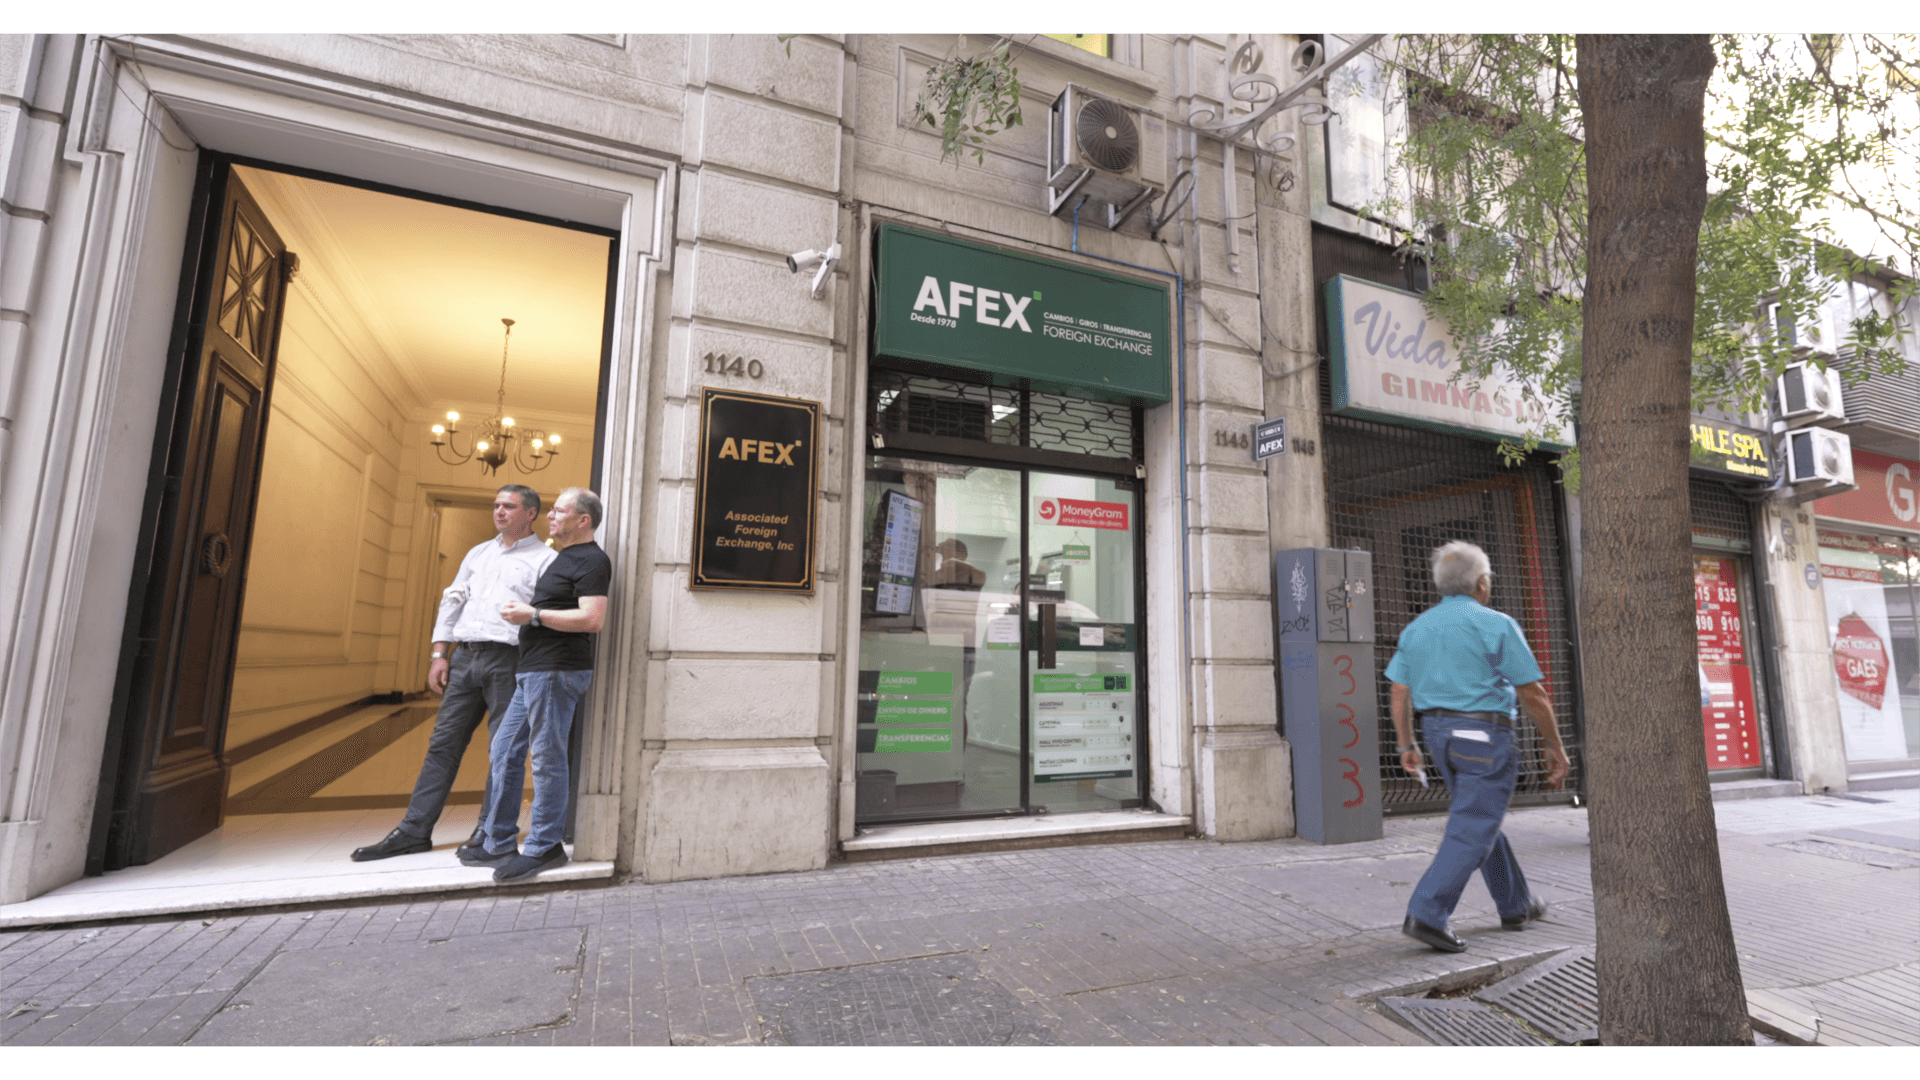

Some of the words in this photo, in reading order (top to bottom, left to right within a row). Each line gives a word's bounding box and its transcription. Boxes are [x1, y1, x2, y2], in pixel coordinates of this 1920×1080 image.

[913, 275, 1032, 333] AFEX
[910, 313, 936, 327] Desde
[937, 316, 957, 328] 1978
[1043, 312, 1074, 324] CAMBIOS
[1079, 319, 1098, 329] GIROS
[1103, 324, 1152, 339] TRANSFERENCIAS
[1043, 325, 1092, 344] FOREIGN
[1094, 335, 1153, 356] EXCHANGE
[1354, 300, 1450, 370] Vida
[704, 352, 764, 379] 1140
[1260, 438, 1283, 453] AFEX
[1690, 424, 1732, 455] HILE
[718, 437, 794, 466] AFEX
[725, 510, 788, 525] Associated
[1062, 504, 1124, 519] MoneyGram
[735, 524, 778, 538] Foreign
[715, 536, 775, 551] Exchange,
[777, 540, 794, 551] Inc
[1718, 587, 1737, 603] 835
[1721, 616, 1740, 631] 910
[1847, 658, 1878, 678] GAES
[880, 676, 917, 685] CAMBIOS
[878, 734, 949, 742] TRANSFERENCIAS
